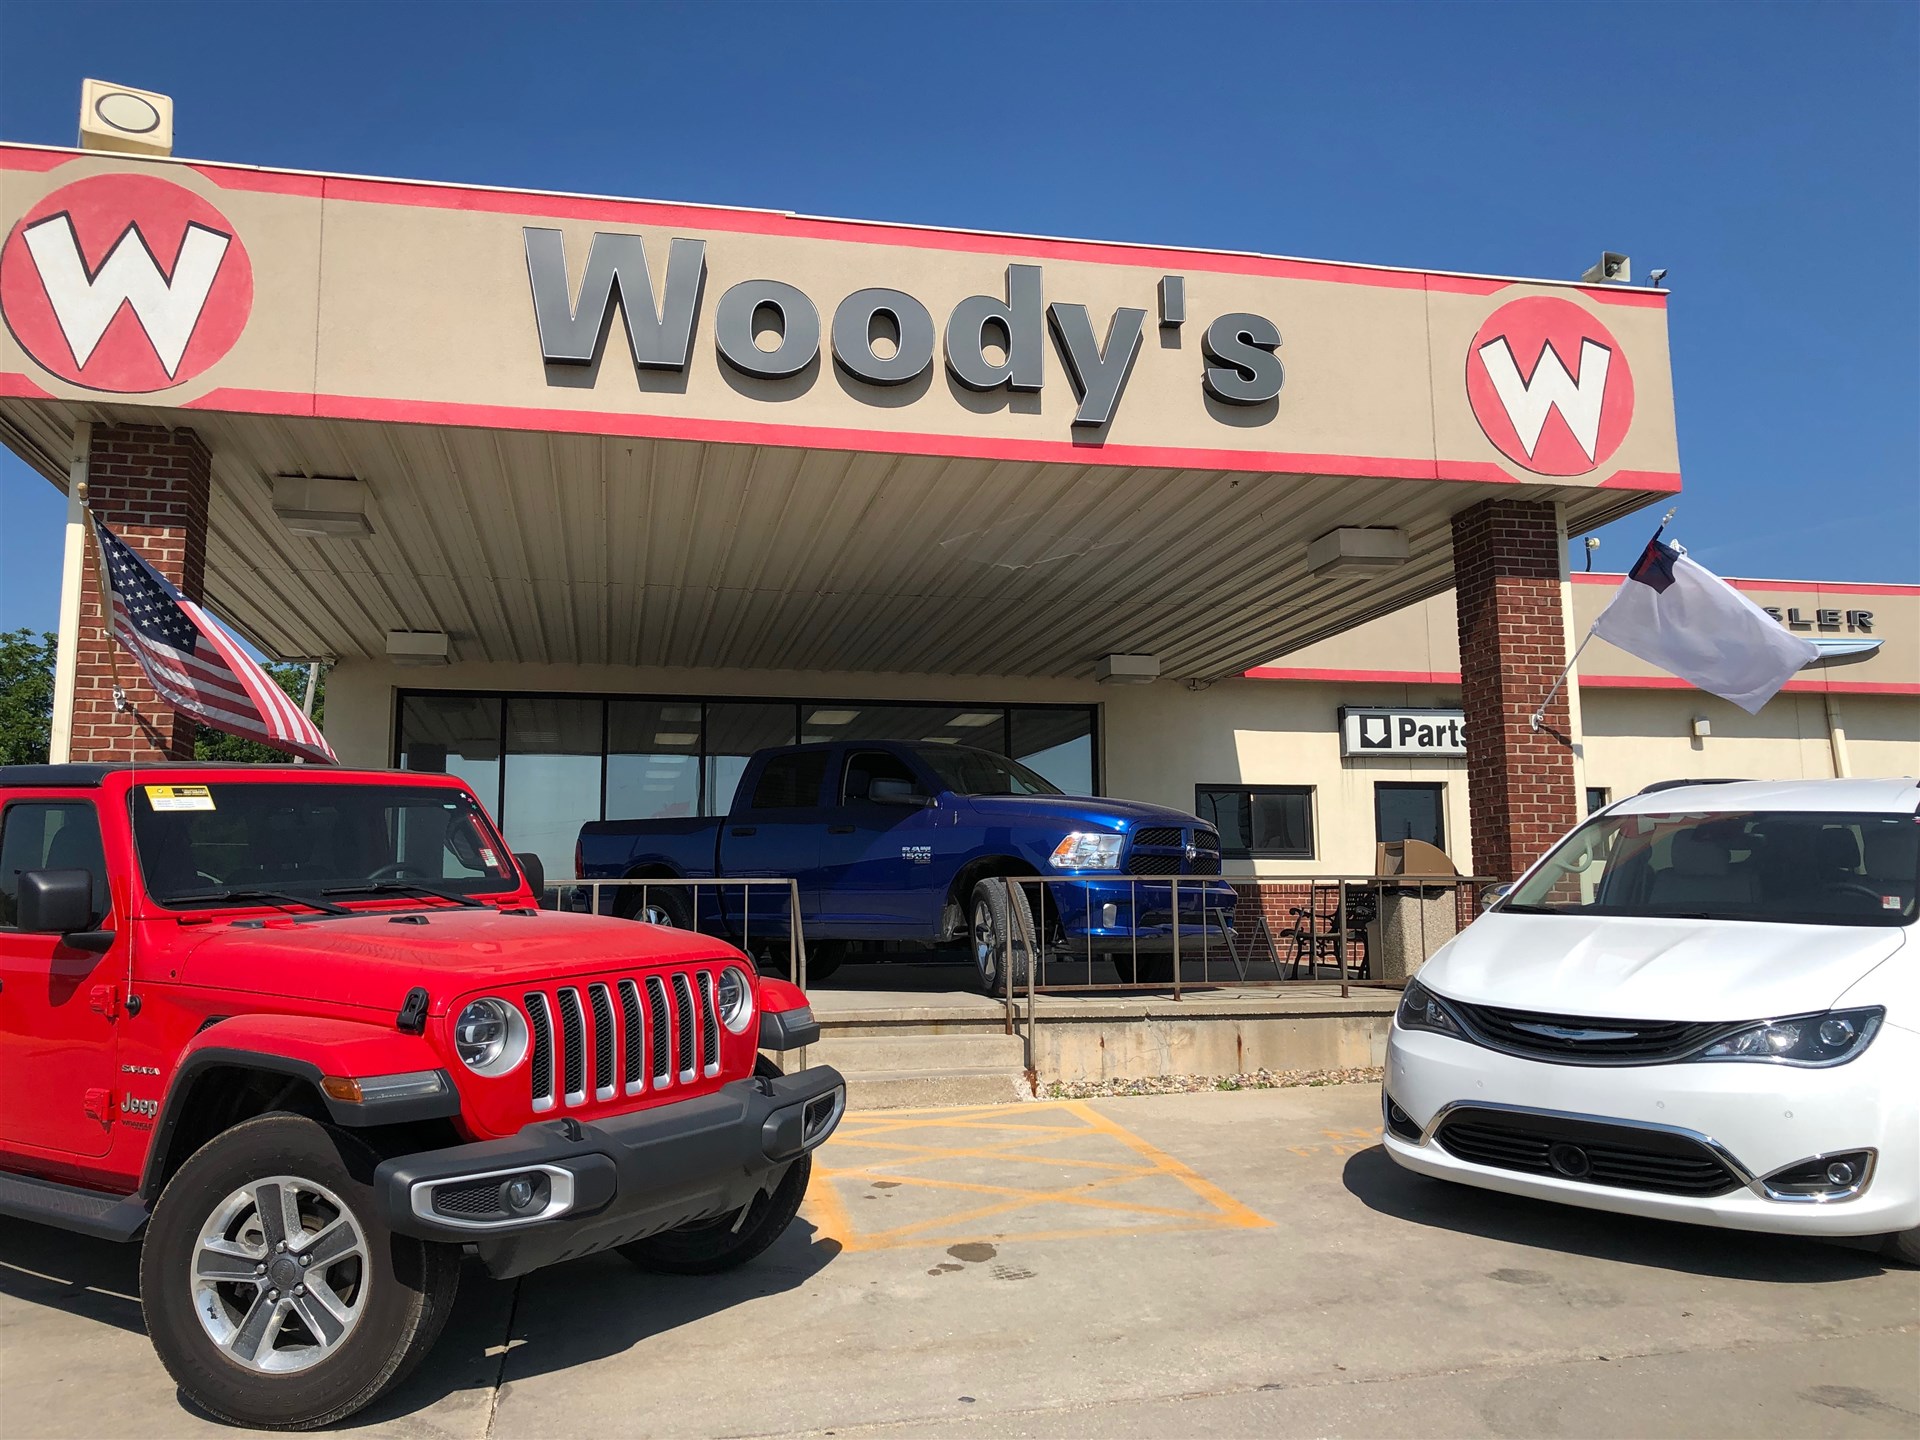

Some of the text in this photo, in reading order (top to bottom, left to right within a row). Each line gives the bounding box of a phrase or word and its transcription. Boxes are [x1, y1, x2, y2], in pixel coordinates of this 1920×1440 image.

[22, 210, 233, 381] W
[522, 226, 1286, 428] Woody's
[1477, 334, 1612, 465] W
[120, 1091, 158, 1119] Jeep
[121, 1064, 160, 1076] SAHARA
